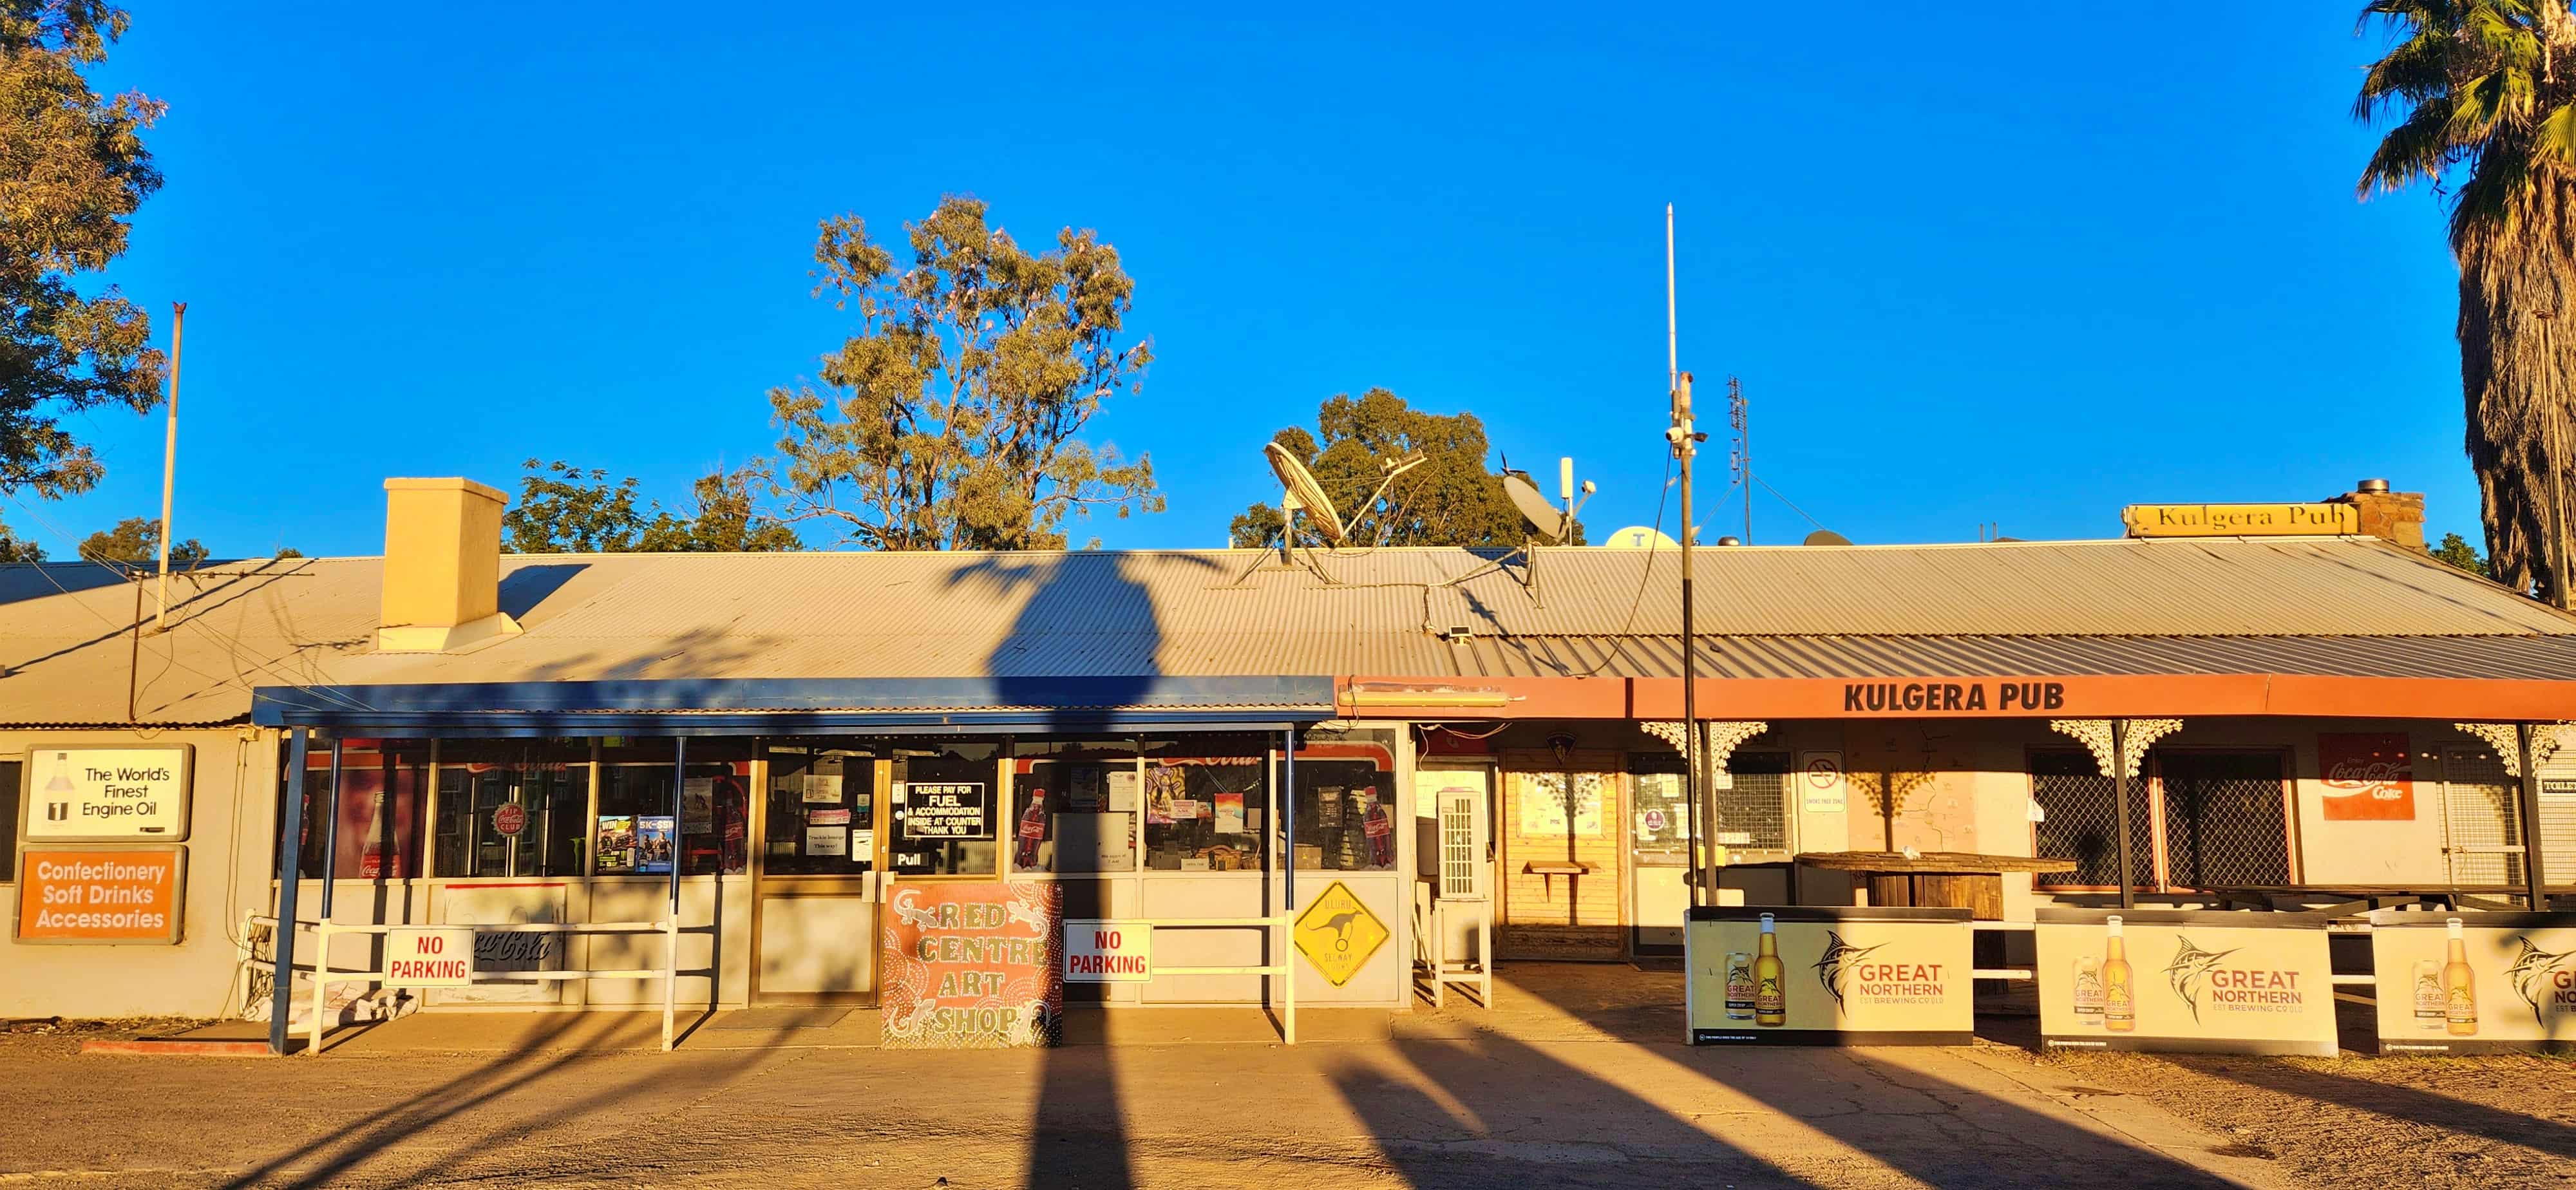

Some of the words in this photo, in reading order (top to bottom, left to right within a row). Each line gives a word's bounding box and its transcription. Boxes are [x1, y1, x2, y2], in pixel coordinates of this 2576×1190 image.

[2159, 505, 2273, 530] Kulgera
[2287, 504, 2344, 524] Pub
[1844, 683, 1987, 711] KULGERA
[2000, 683, 2065, 710] PUB
[85, 768, 112, 781] The
[117, 768, 170, 781] World's
[2328, 762, 2401, 786] Coca-Cola
[104, 784, 149, 798] Finest
[915, 786, 942, 794] PLEASE
[943, 786, 956, 794] PAY
[957, 786, 972, 794] FOR
[2372, 786, 2403, 800] Coke
[82, 802, 133, 818] Engine
[136, 801, 156, 815] Oil
[929, 795, 961, 807] FUEL
[907, 807, 914, 816] &
[915, 807, 980, 816] ACCOMMODATION
[601, 820, 618, 831] WIN
[907, 817, 932, 826] INSIDE
[934, 817, 943, 826] AT
[945, 817, 981, 826] COUNTER
[923, 826, 949, 835] THANK
[951, 826, 967, 835] YOU
[898, 853, 920, 865] Pull
[37, 861, 166, 884] Confectionery
[43, 885, 82, 903] Soft
[90, 885, 154, 903] Drinks
[1325, 899, 1351, 909] ULURU
[35, 909, 164, 927] Accessories
[938, 902, 1007, 929] RED
[417, 936, 443, 954] NO
[1095, 931, 1121, 949] NO
[918, 936, 1048, 967] CENTRE
[391, 960, 466, 978] PARKING
[1070, 955, 1146, 974] PARKING
[1859, 965, 1942, 981] GREAT
[938, 970, 1005, 997] ART
[2211, 970, 2300, 989] GREAT
[1860, 984, 1943, 996] NORTHERN
[2213, 990, 2302, 1004] NORTHERN
[934, 1006, 1019, 1035] SHOP
